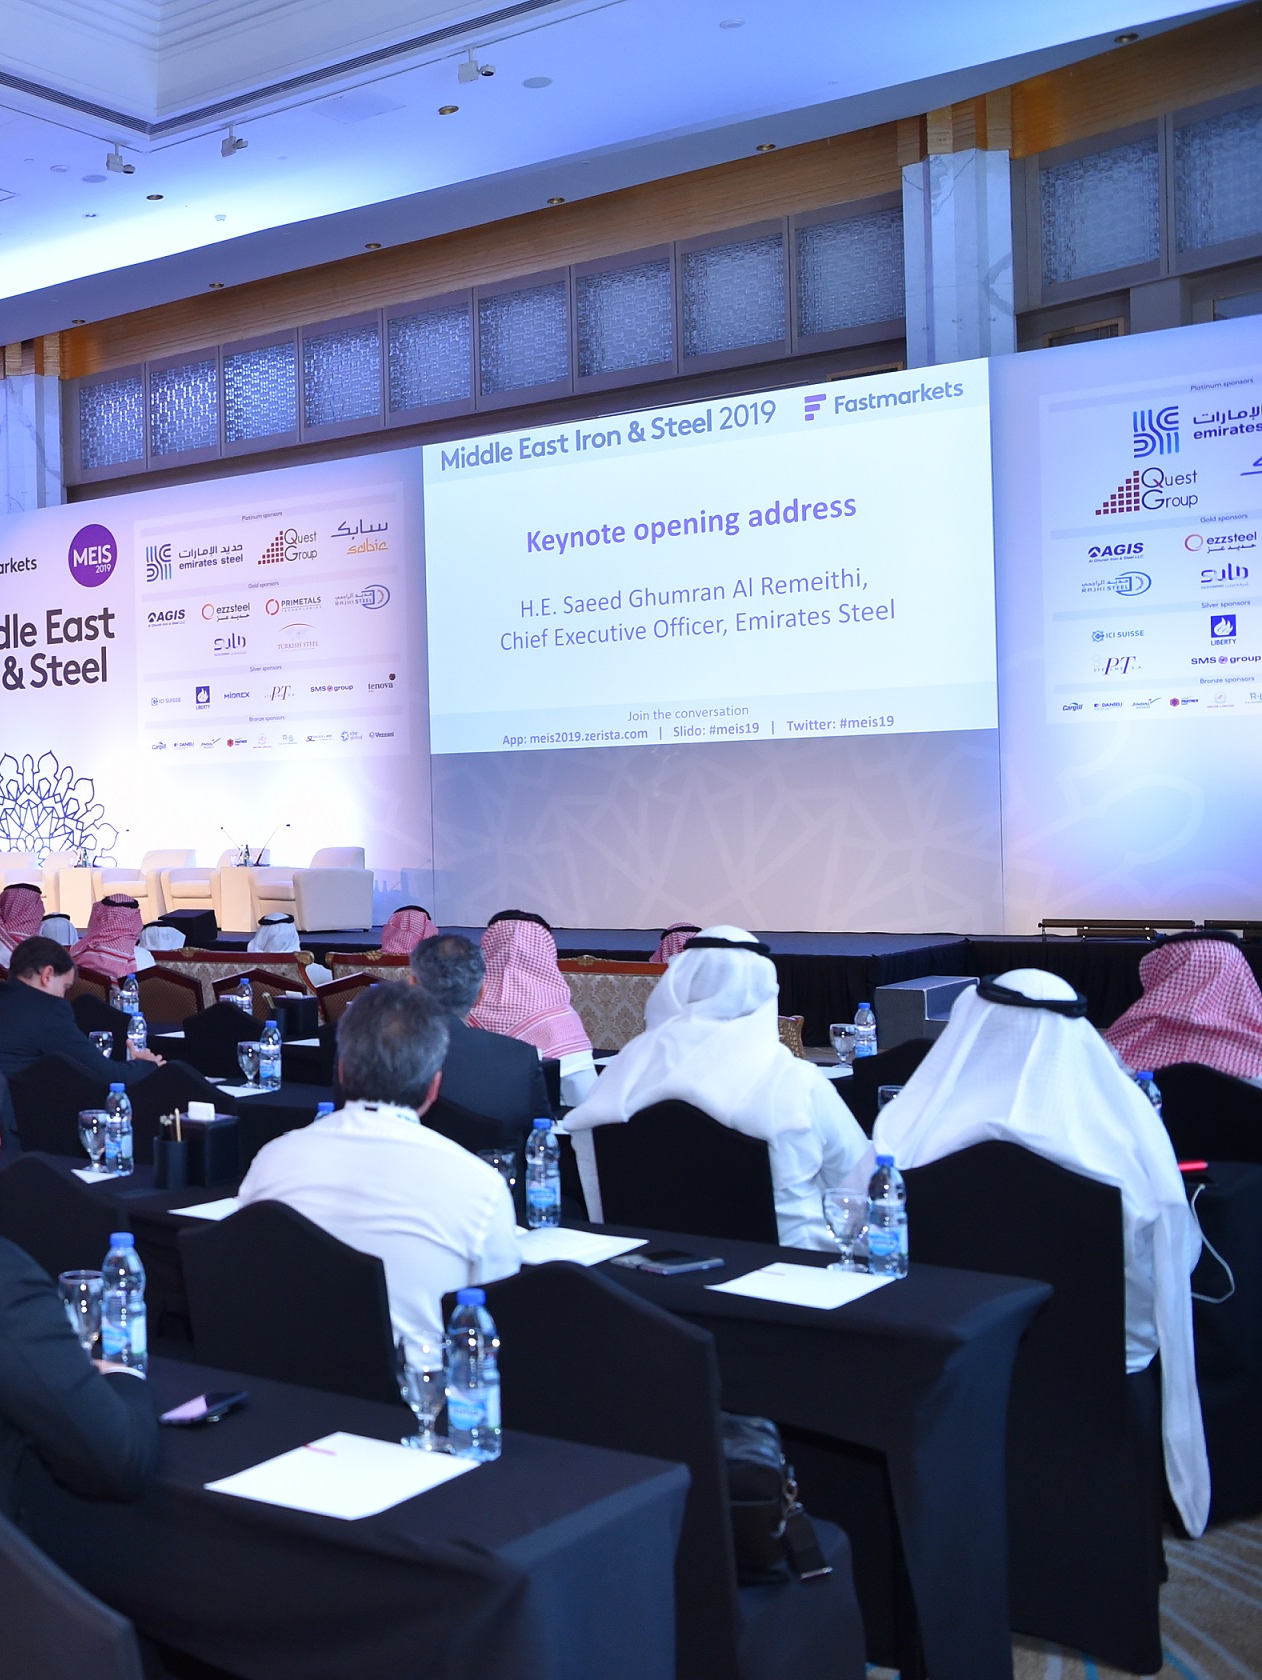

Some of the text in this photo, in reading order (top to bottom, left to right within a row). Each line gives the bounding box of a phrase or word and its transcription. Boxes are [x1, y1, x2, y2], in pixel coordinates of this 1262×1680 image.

[1191, 378, 1253, 392] Platinum sponsors
[834, 381, 964, 415] Fastmarkets
[441, 400, 777, 471] Middle East Iron & Steel 2019
[1193, 423, 1262, 440] emirates
[1141, 467, 1198, 488] Quest
[1141, 489, 1198, 510] Group
[263, 511, 283, 519] sponsors
[1217, 513, 1248, 523] sponsors
[527, 498, 857, 555] Keynote opening address
[284, 528, 317, 545] Quest
[1206, 531, 1257, 545] ezzsteel
[73, 544, 112, 567] MEIS
[220, 544, 243, 554] حديد
[284, 545, 317, 561] Group
[1101, 542, 1144, 557] AGIS
[95, 564, 111, 574] 2019
[179, 554, 243, 570] emirates steel
[521, 567, 868, 618] H.E. Saeed Ghumran Al Remeithi,
[216, 602, 250, 614] ezzsteel
[281, 596, 321, 607] PRIMETALS
[1221, 600, 1250, 608] sponsors
[156, 609, 186, 622] AGIS
[46, 607, 115, 645] East
[501, 598, 895, 650] Chief Executive Officer, Emirates Steel
[1117, 630, 1145, 638] SUISSE
[1103, 656, 1136, 675] PT
[1191, 655, 1262, 665] SMS group
[2, 656, 26, 691] &
[30, 646, 107, 689] Steel
[368, 682, 394, 690] tenova
[1224, 676, 1255, 684] sponsors
[271, 685, 292, 701] PT
[628, 705, 749, 722] Join the conversation
[503, 715, 894, 747] App: meis2019.zerista.com Slido: #meis19 Twitter: #meis19
